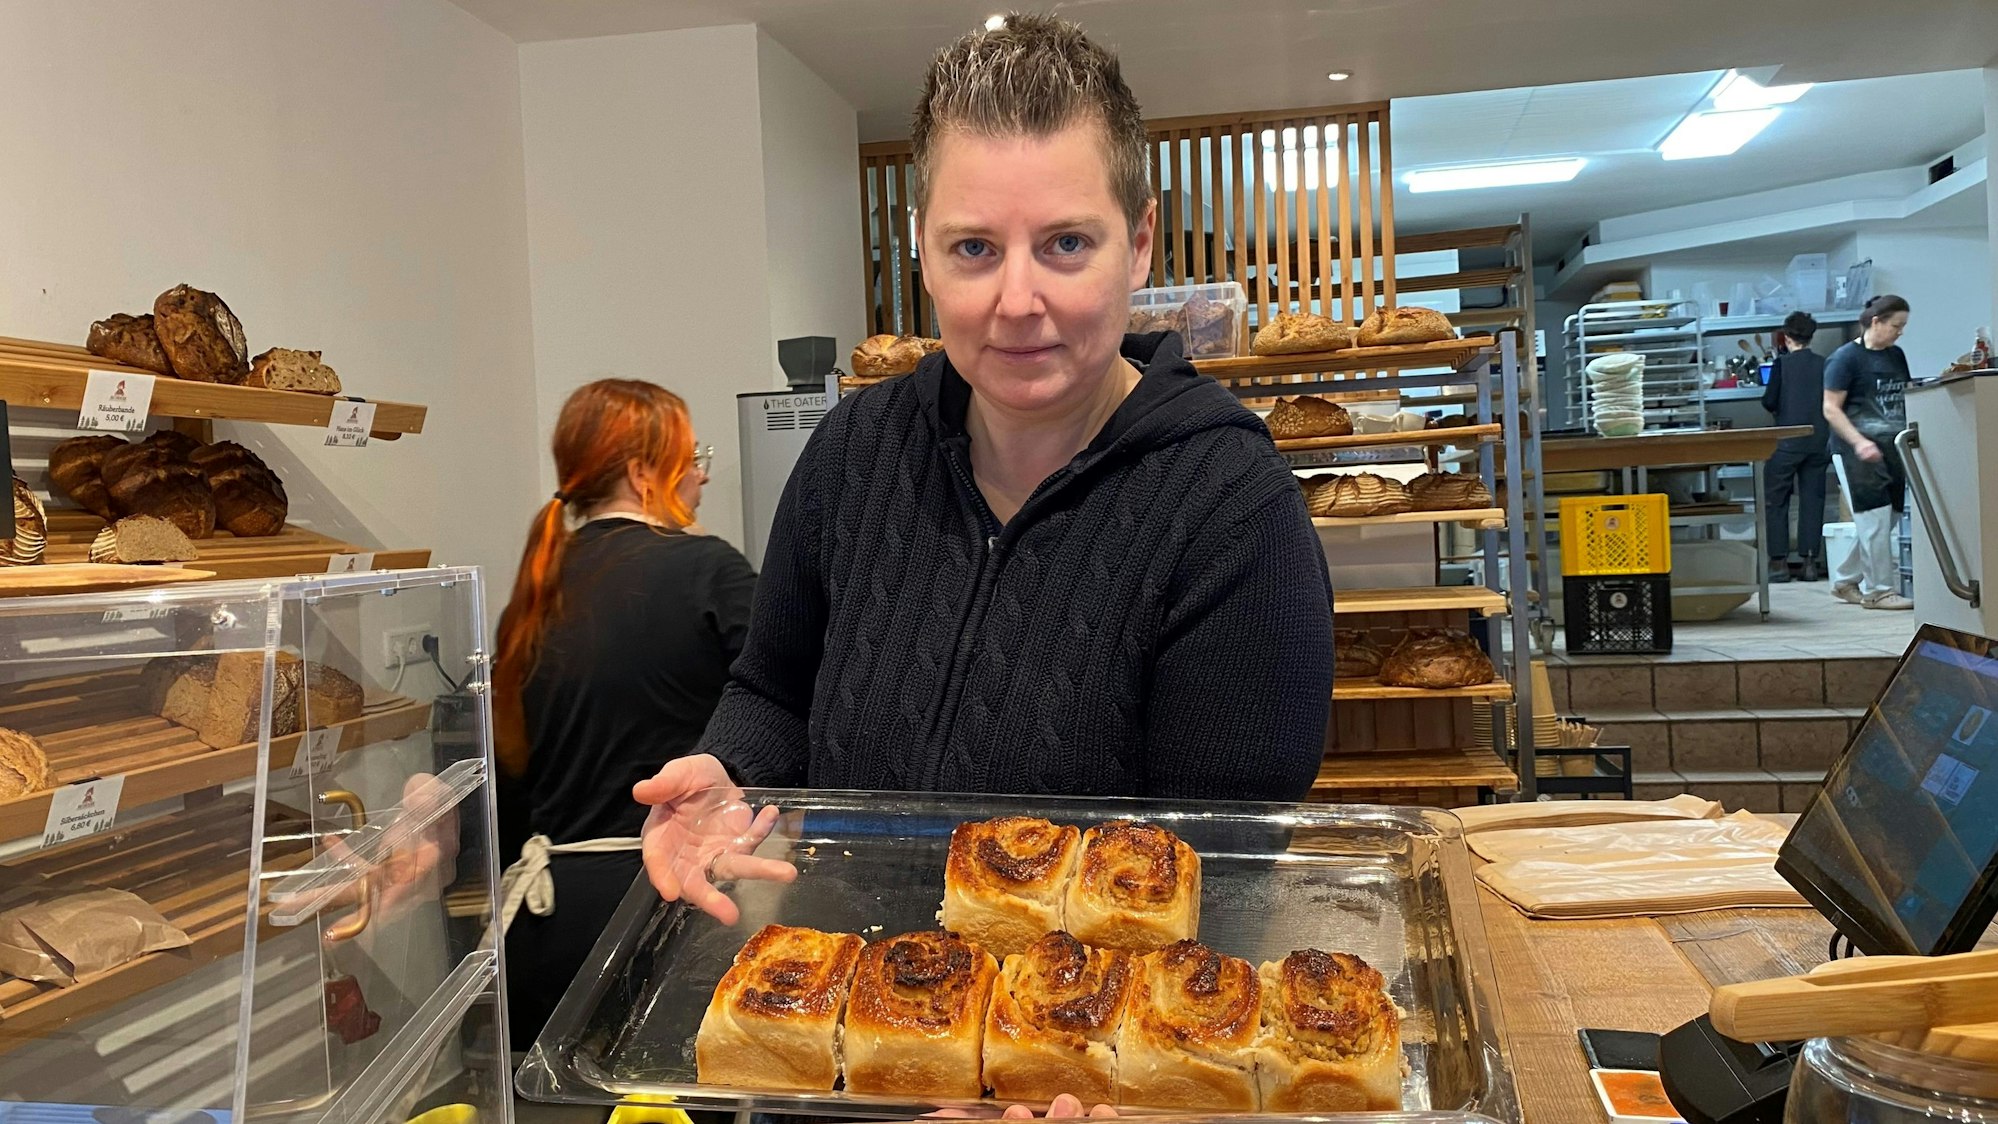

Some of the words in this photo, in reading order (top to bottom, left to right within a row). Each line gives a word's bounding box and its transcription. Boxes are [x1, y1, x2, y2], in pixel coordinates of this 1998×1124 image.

[770, 398, 791, 408] THE
[105, 414, 119, 422] 5,00
[120, 414, 125, 422] €
